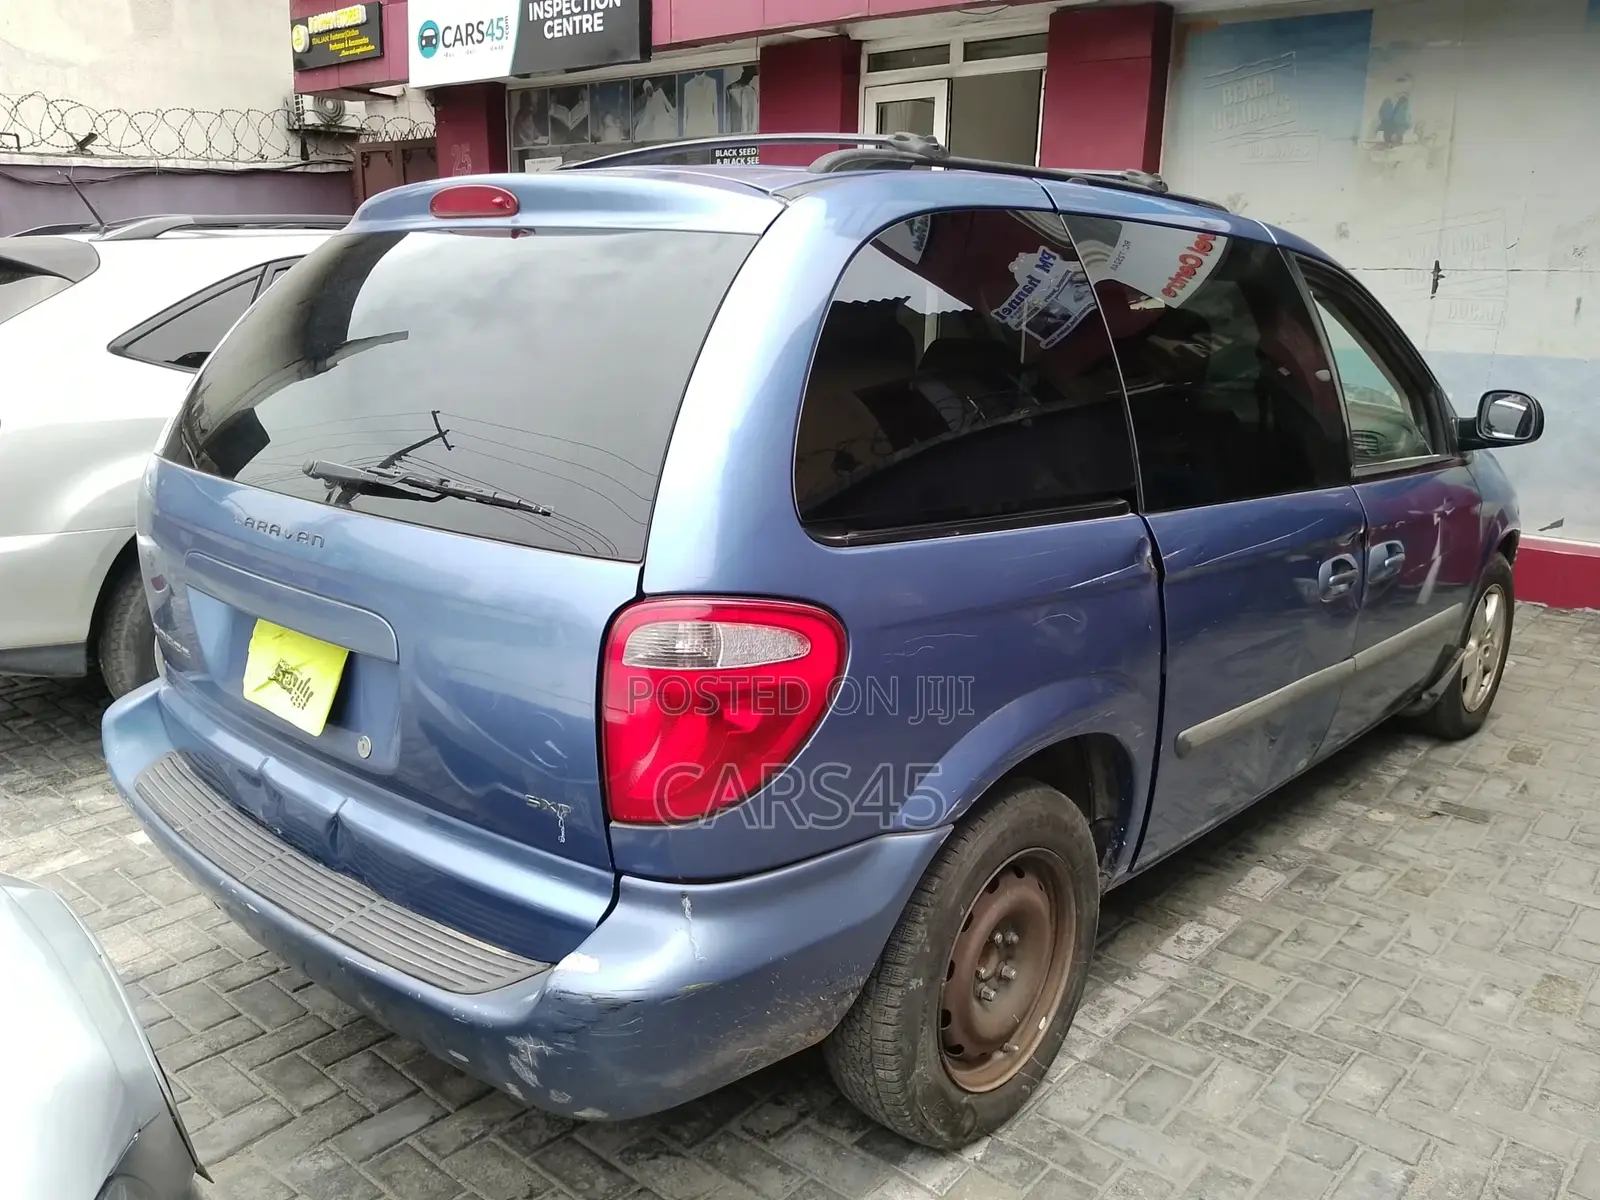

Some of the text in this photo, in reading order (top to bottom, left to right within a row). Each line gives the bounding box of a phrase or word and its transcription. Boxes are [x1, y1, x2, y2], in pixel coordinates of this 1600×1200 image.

[442, 17, 504, 48] CARS45
[543, 12, 604, 39] CENTRE
[715, 149, 738, 157] BLACK
[723, 157, 745, 165] BLACK
